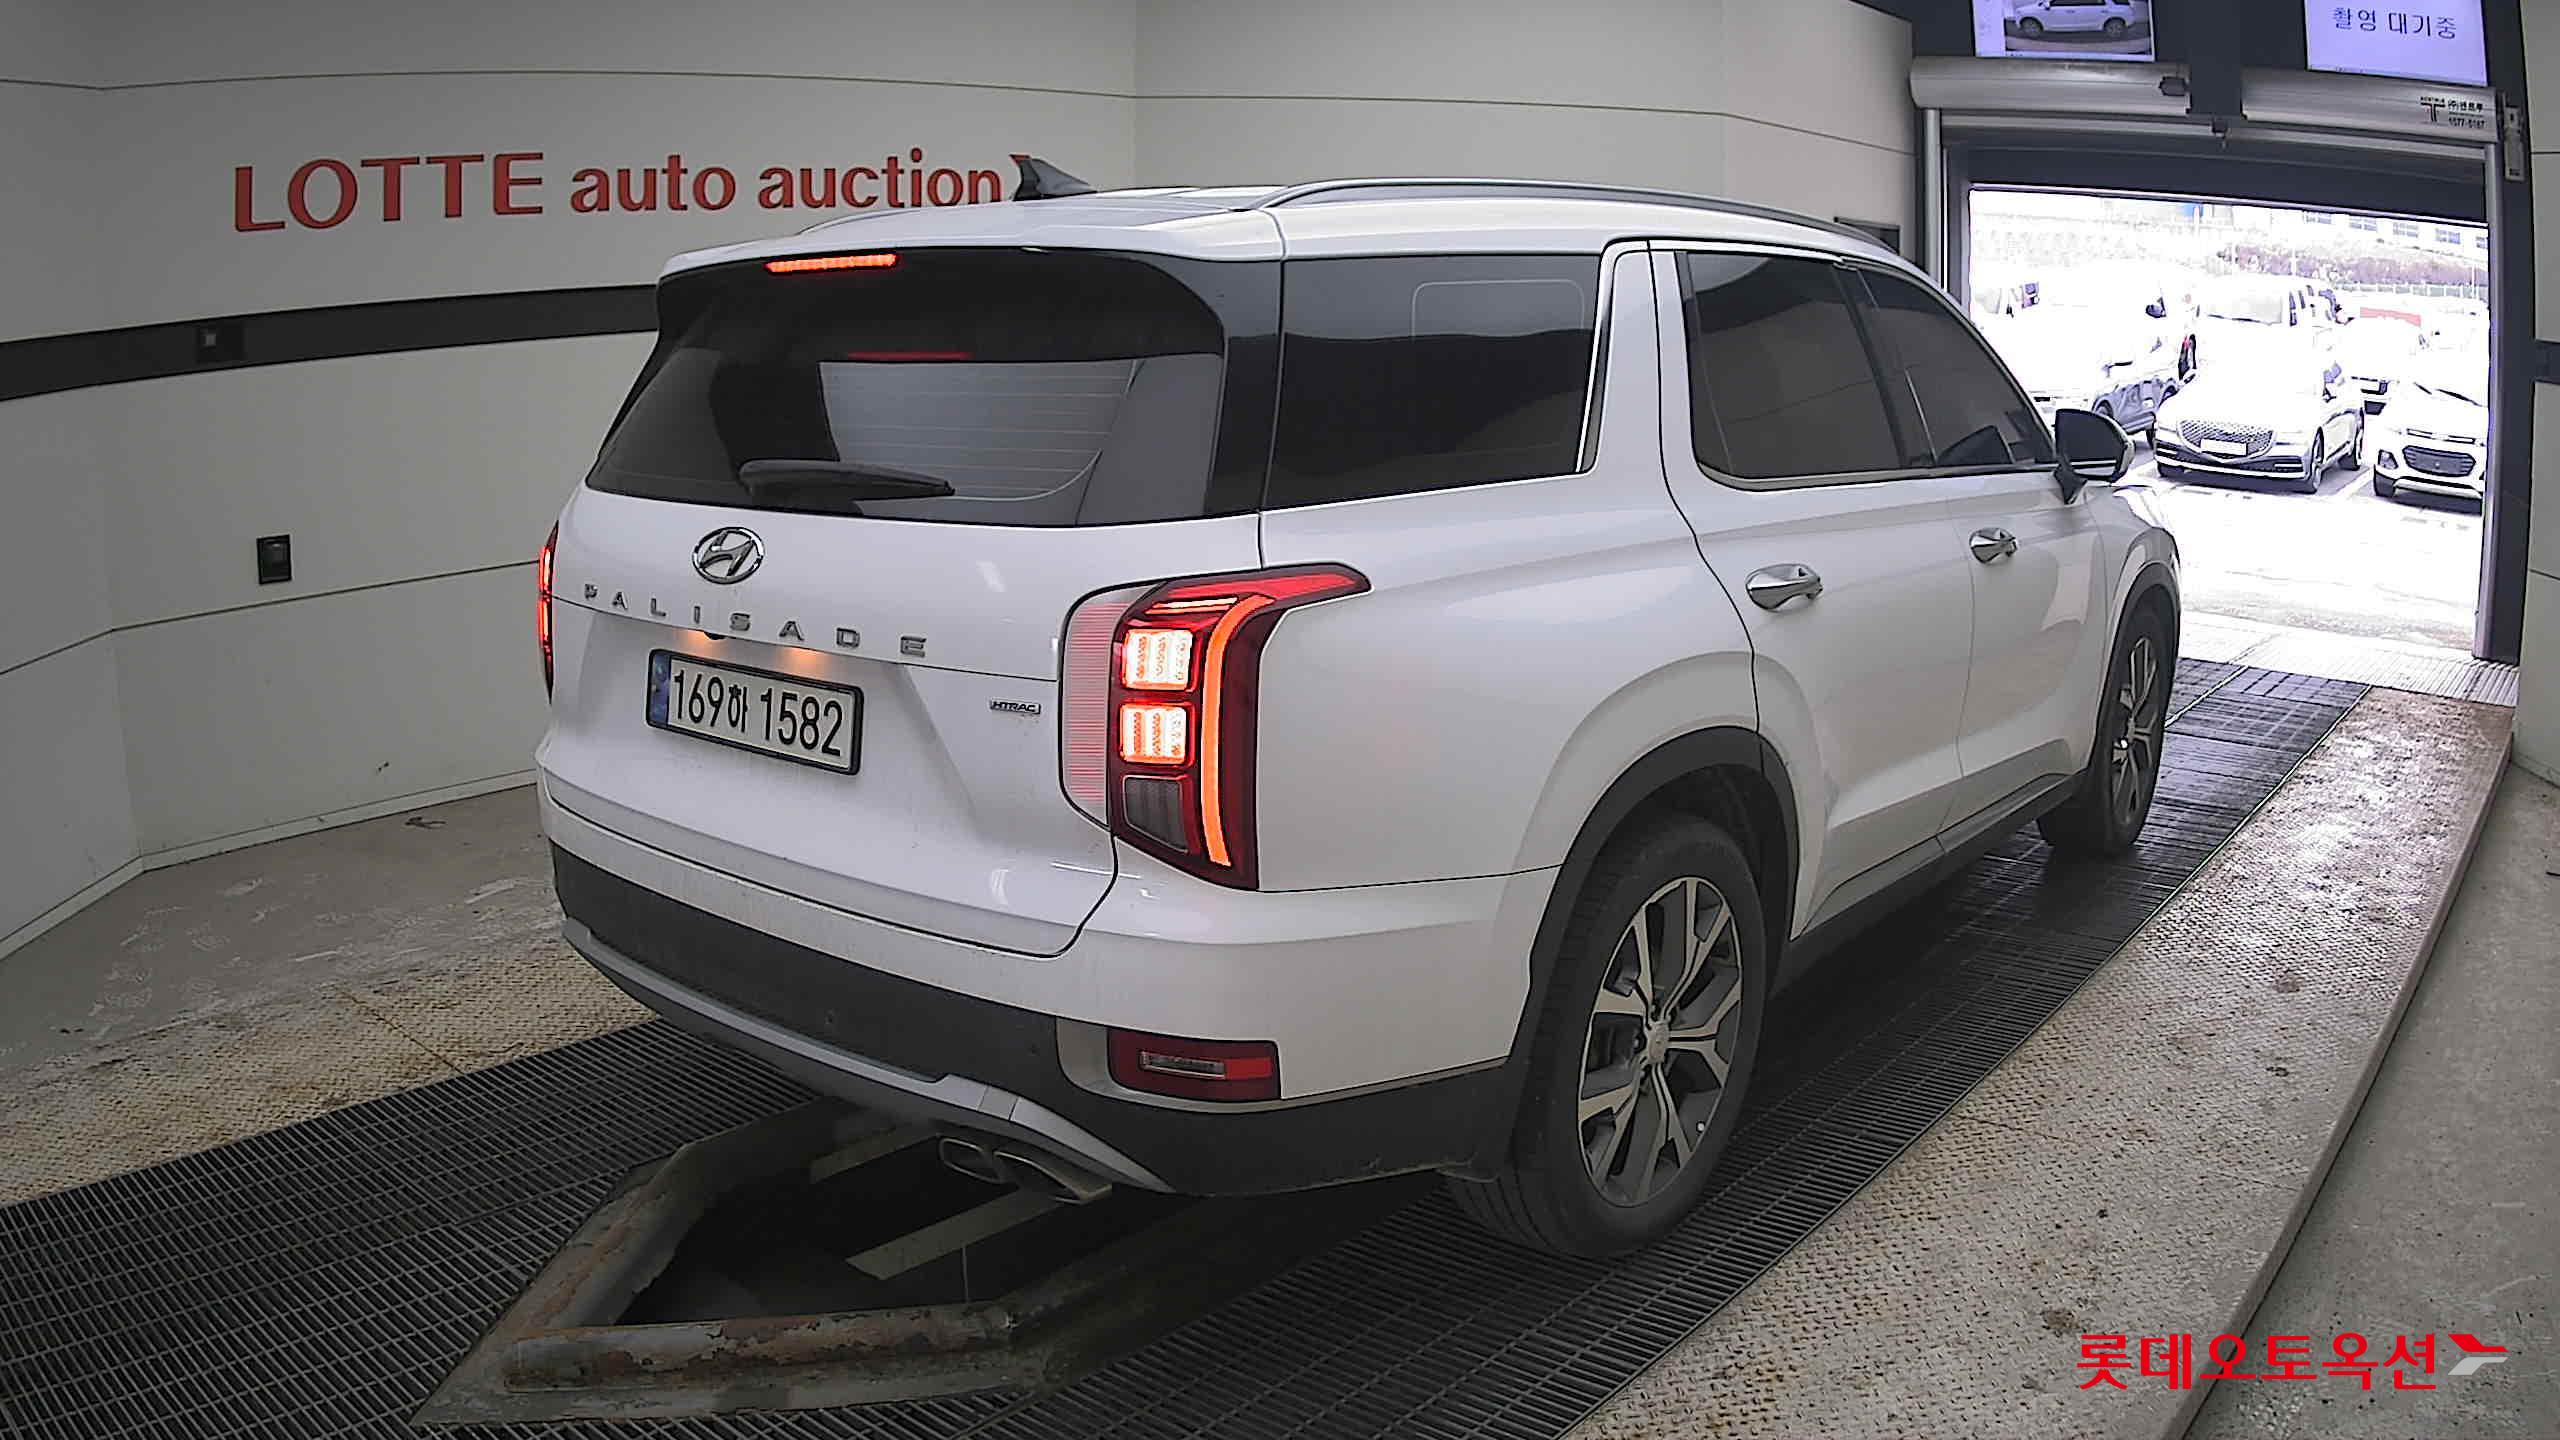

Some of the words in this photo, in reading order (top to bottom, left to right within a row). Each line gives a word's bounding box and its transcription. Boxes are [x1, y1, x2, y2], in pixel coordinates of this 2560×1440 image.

[2334, 7, 2377, 32] 촬영
[2388, 12, 2457, 40] 대기중
[234, 152, 544, 232] LOTTE
[569, 154, 737, 213] auto
[757, 147, 1003, 209] auction
[584, 583, 927, 658] PALISADE
[674, 669, 748, 733] 169하
[760, 687, 843, 757] 1582
[991, 700, 1040, 714] HTRAC
